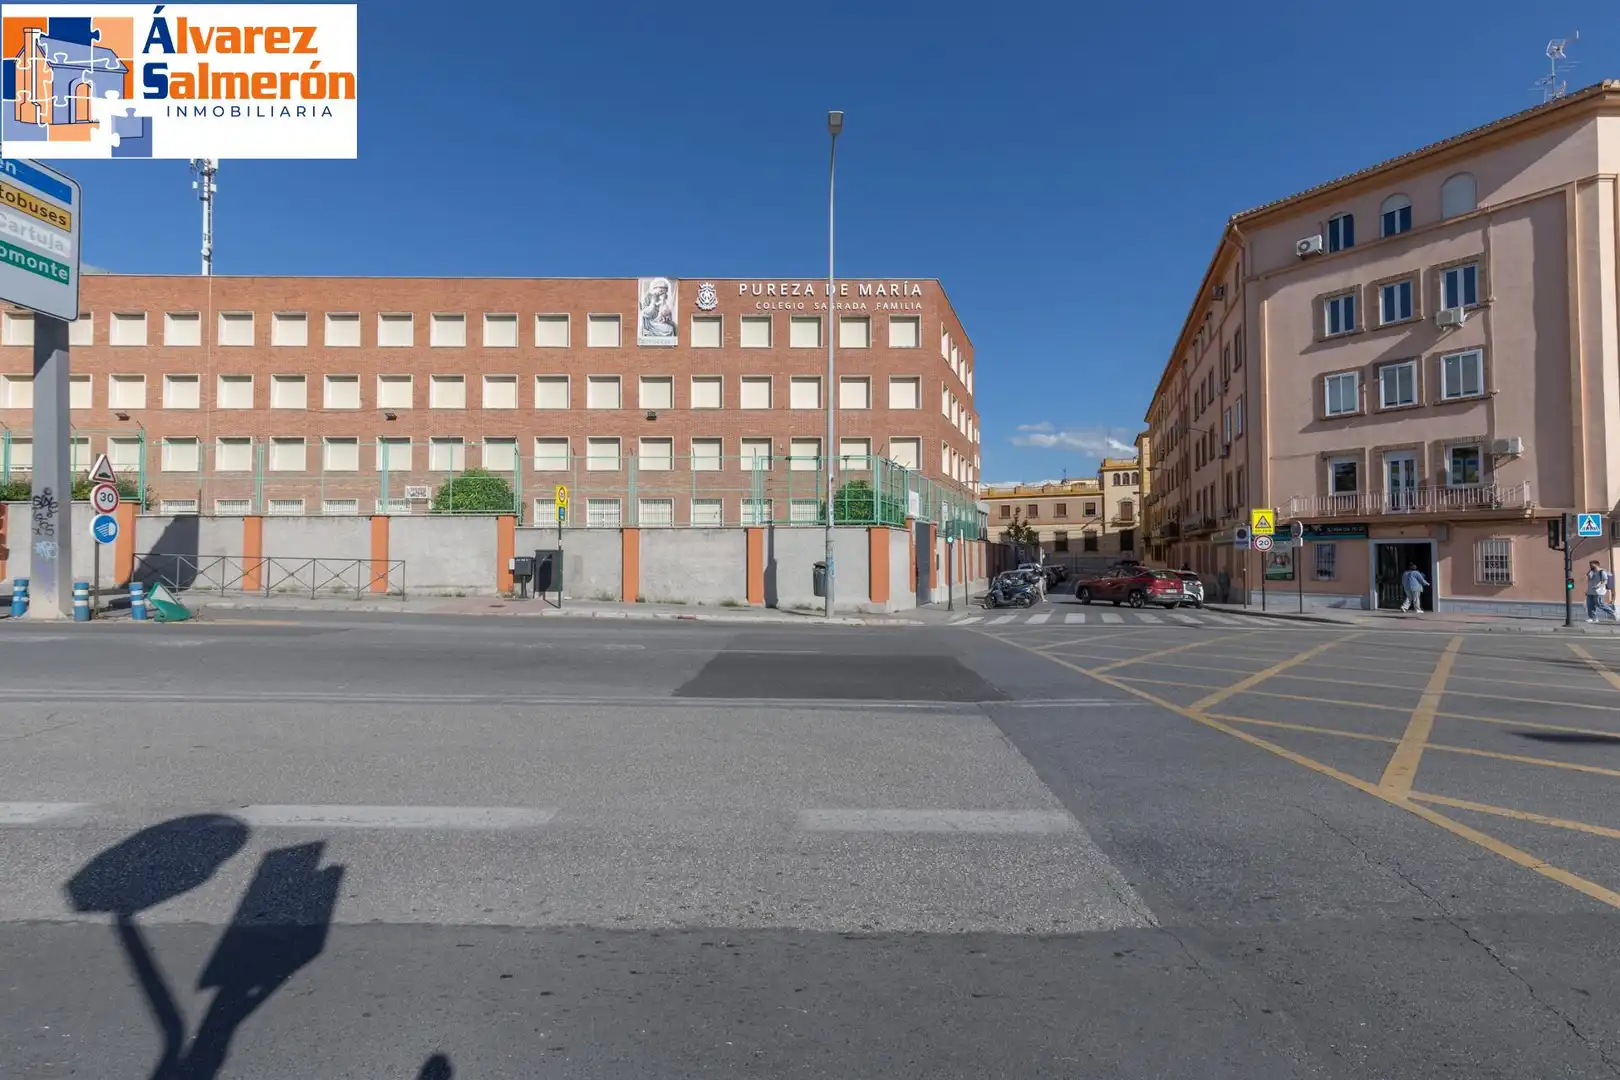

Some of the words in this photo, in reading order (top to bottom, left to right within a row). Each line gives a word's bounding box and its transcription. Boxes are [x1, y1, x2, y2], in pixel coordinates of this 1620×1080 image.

[0, 185, 67, 226] tobuses
[0, 211, 64, 250] Cartuja
[739, 283, 815, 296] PUREZA
[825, 283, 848, 296] DE
[858, 280, 922, 296] MARÍA
[755, 302, 805, 310] COLEGIO
[813, 302, 867, 310] SARADA
[876, 302, 922, 310] FAMILIA
[100, 491, 114, 503] 30
